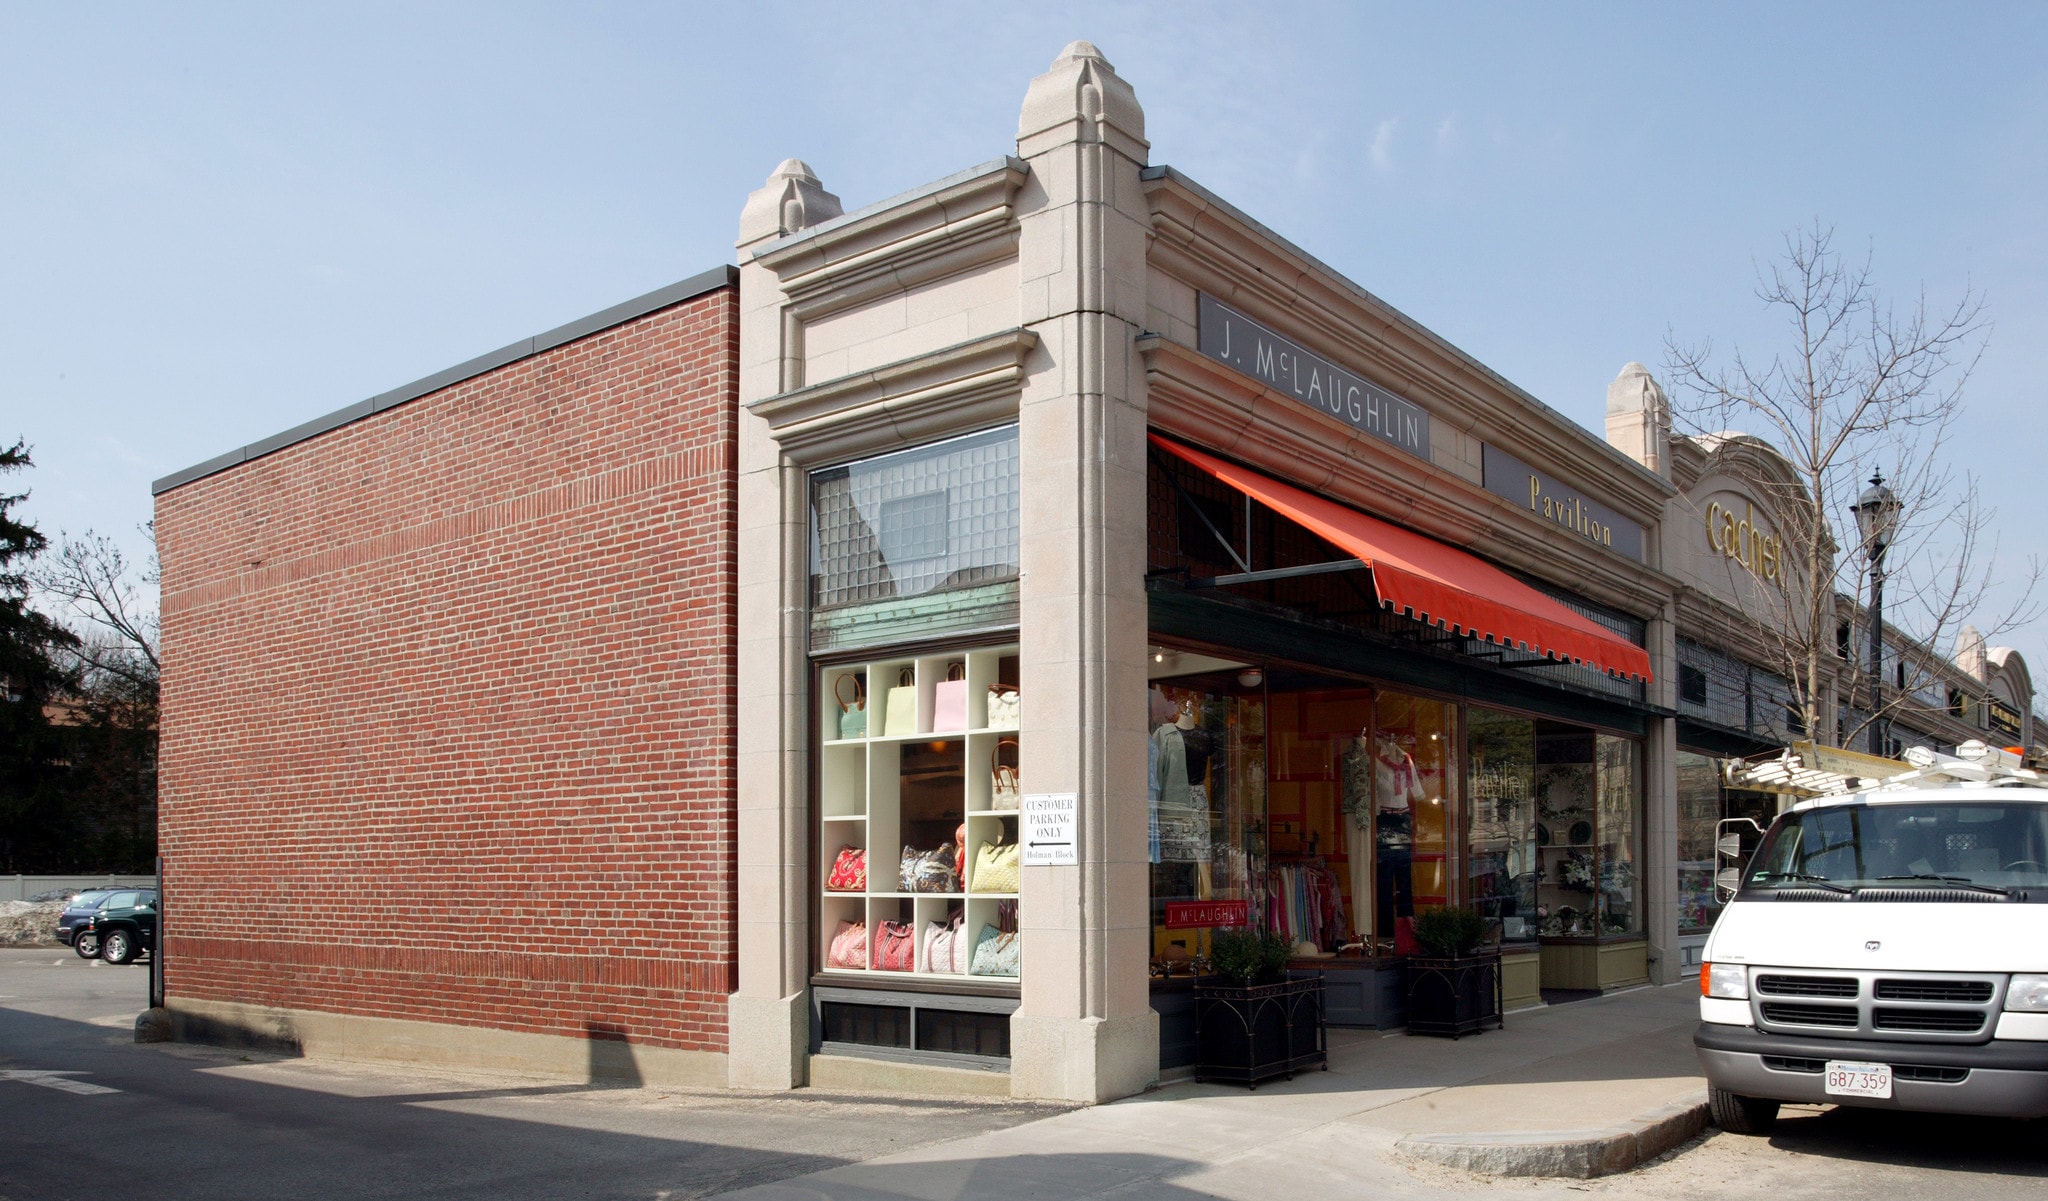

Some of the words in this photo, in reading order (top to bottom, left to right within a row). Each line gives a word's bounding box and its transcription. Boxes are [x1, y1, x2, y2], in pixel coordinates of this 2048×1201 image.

[1220, 320, 1241, 364] J.
[1256, 337, 1418, 449] McLAUGHLIN
[1529, 474, 1611, 547] Pavilion
[1706, 501, 1785, 588] Cachet
[1026, 799, 1073, 811] CUSTOMER
[1030, 813, 1070, 825] PARKING
[1036, 827, 1062, 838] ONLY
[1027, 850, 1052, 859] Holman
[1055, 850, 1074, 859] Block
[1168, 909, 1176, 923] J.
